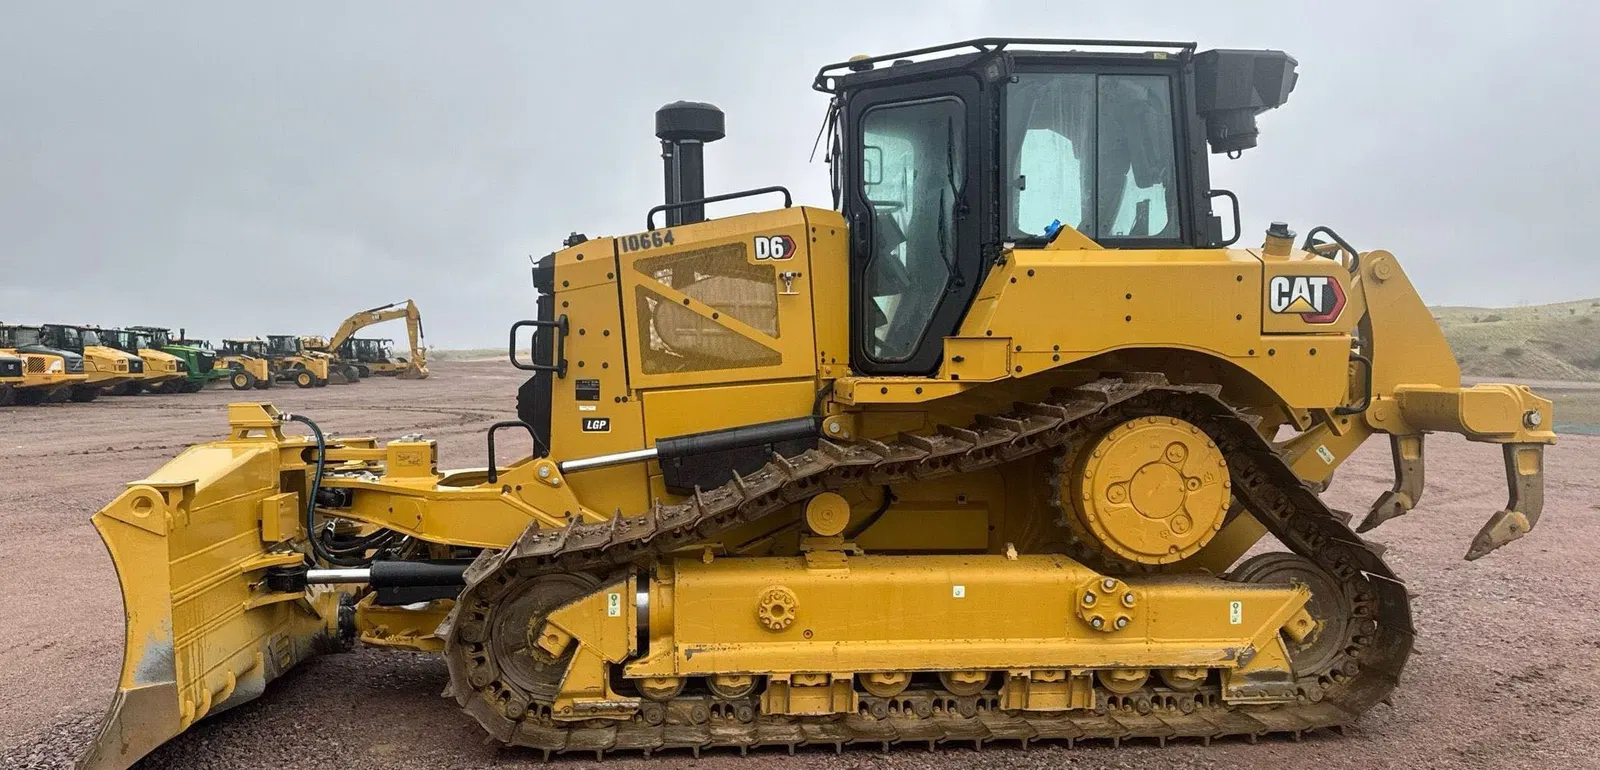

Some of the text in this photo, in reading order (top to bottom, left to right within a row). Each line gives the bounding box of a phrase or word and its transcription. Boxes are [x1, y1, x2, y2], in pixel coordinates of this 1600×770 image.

[622, 229, 675, 253] 10664
[755, 236, 784, 259] D6
[1271, 276, 1328, 313] CAT
[586, 419, 607, 430] LGP
